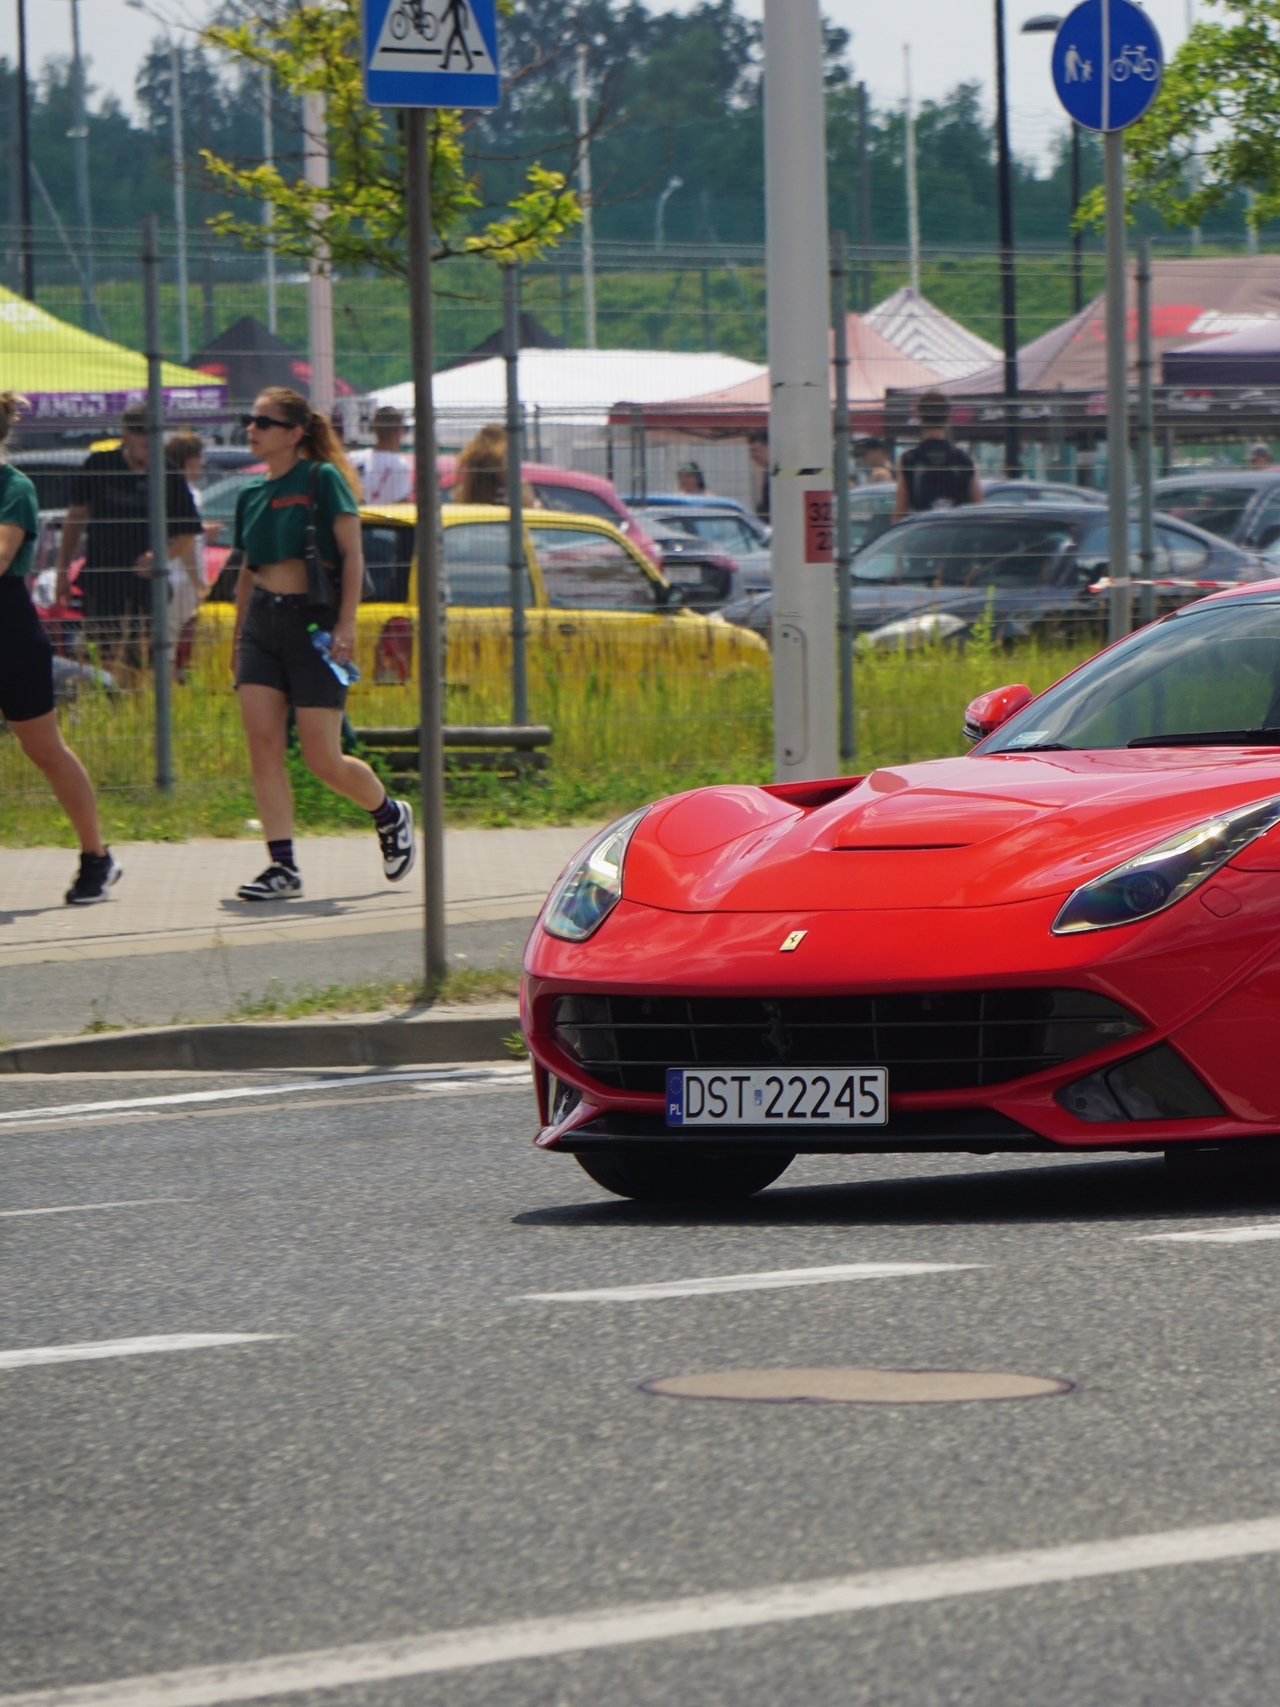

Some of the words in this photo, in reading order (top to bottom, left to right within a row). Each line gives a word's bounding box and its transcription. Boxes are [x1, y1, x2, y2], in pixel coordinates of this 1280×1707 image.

[669, 1104, 682, 1115] PL
[685, 1076, 751, 1118] DST
[765, 1076, 879, 1118] 22245
